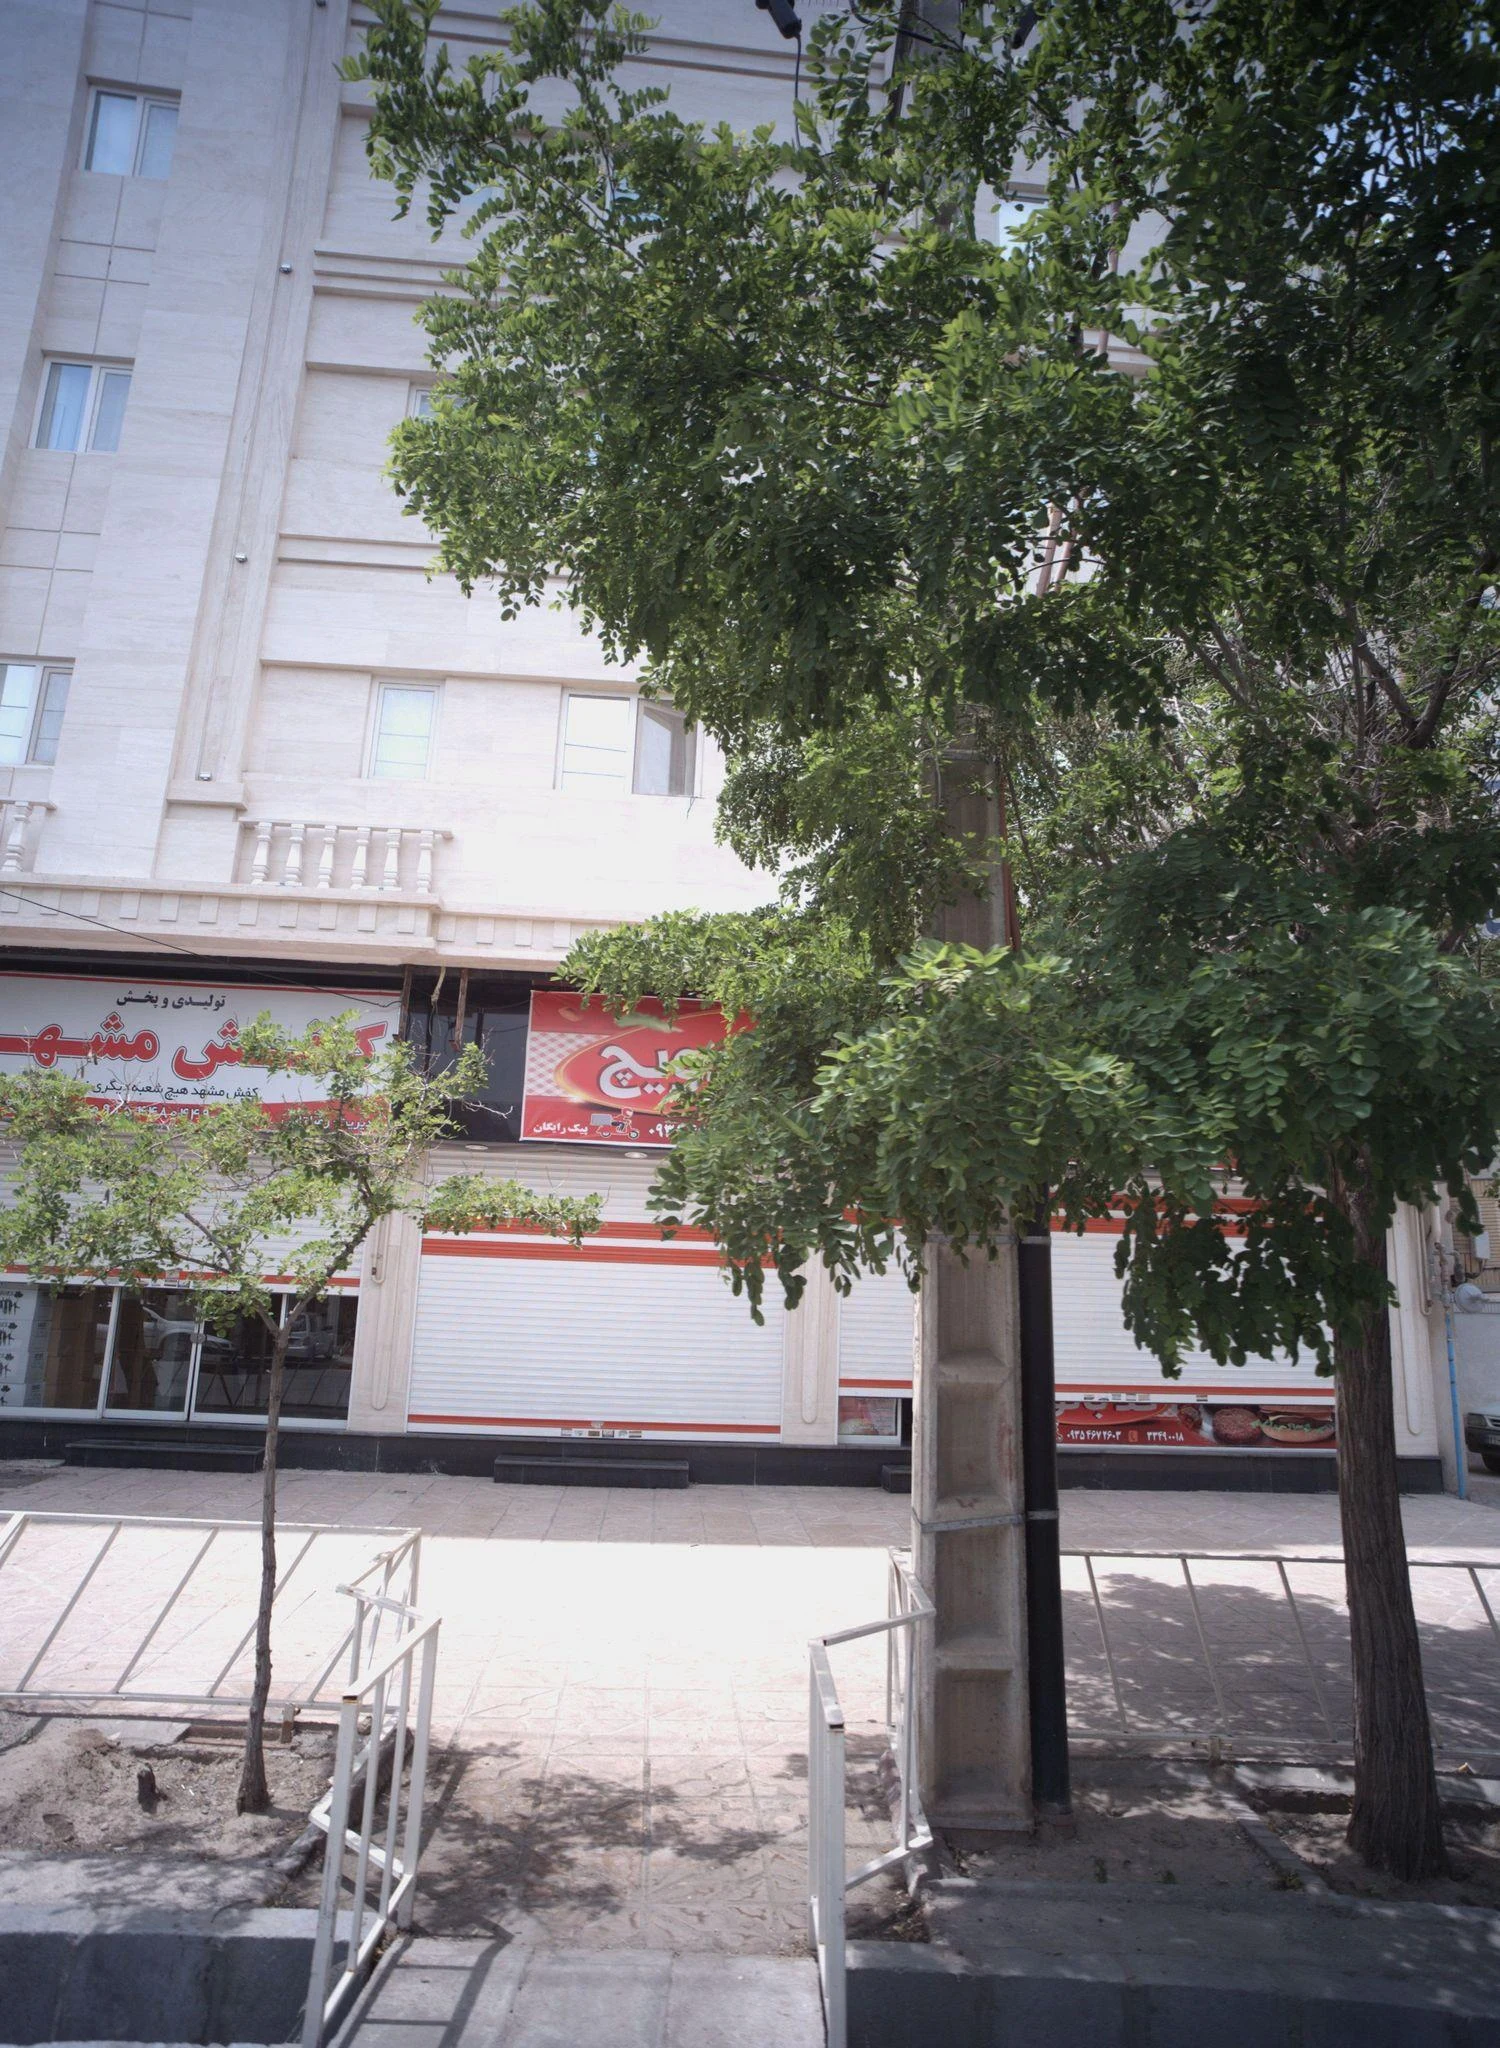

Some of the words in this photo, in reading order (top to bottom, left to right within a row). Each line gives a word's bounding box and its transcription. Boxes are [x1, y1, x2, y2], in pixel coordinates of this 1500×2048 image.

[116, 990, 158, 1008] پخش
[161, 997, 168, 1008] و
[172, 994, 226, 1011] تولیدی
[0, 1011, 160, 1069] مشه
[131, 1081, 163, 1097] شعبه
[165, 1086, 188, 1100] هیچ
[191, 1084, 224, 1098] مشهد
[226, 1087, 259, 1100] کفش
[533, 1121, 566, 1135] رایگان
[567, 1123, 588, 1135] پیک
